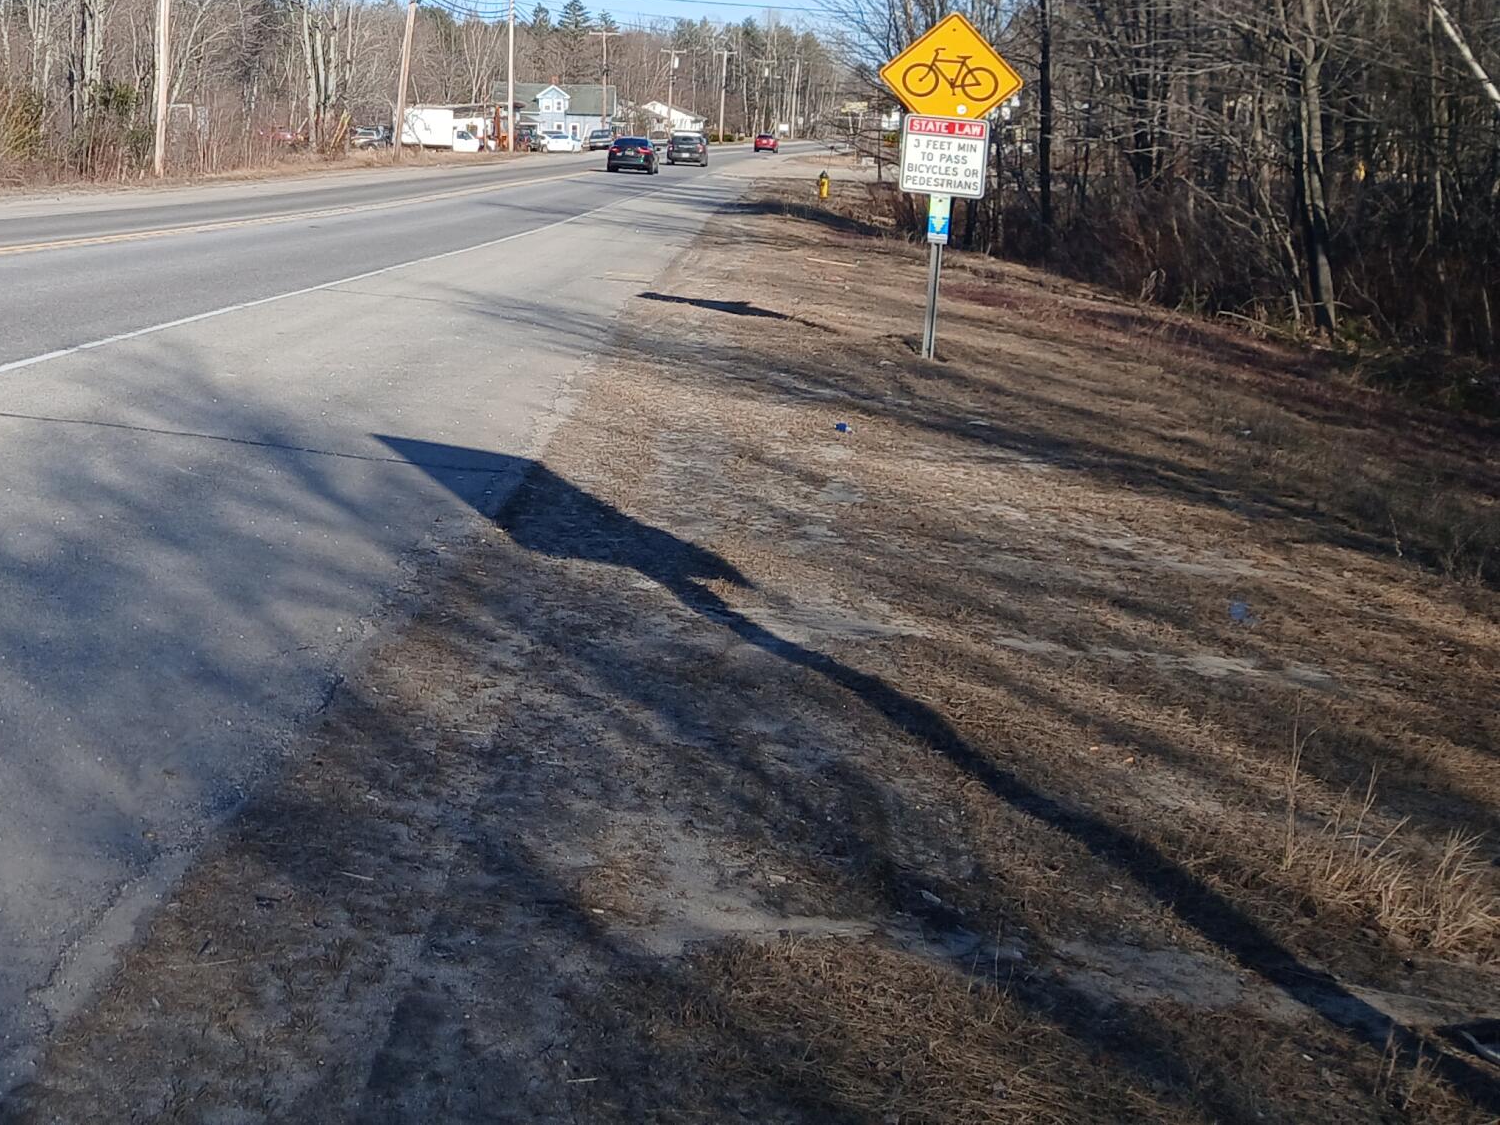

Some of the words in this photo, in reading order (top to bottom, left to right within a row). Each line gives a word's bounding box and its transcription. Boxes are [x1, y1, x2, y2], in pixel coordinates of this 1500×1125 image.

[912, 119, 949, 133] STATE
[954, 123, 981, 136] LAW
[913, 138, 920, 148] 3
[926, 139, 952, 151] FEET
[957, 142, 977, 153] MIN
[921, 151, 934, 162] TO
[939, 153, 968, 165] PASS
[907, 163, 958, 177] BICYCLES
[964, 168, 979, 178] OR
[905, 175, 978, 191] PEDESTRIANS
